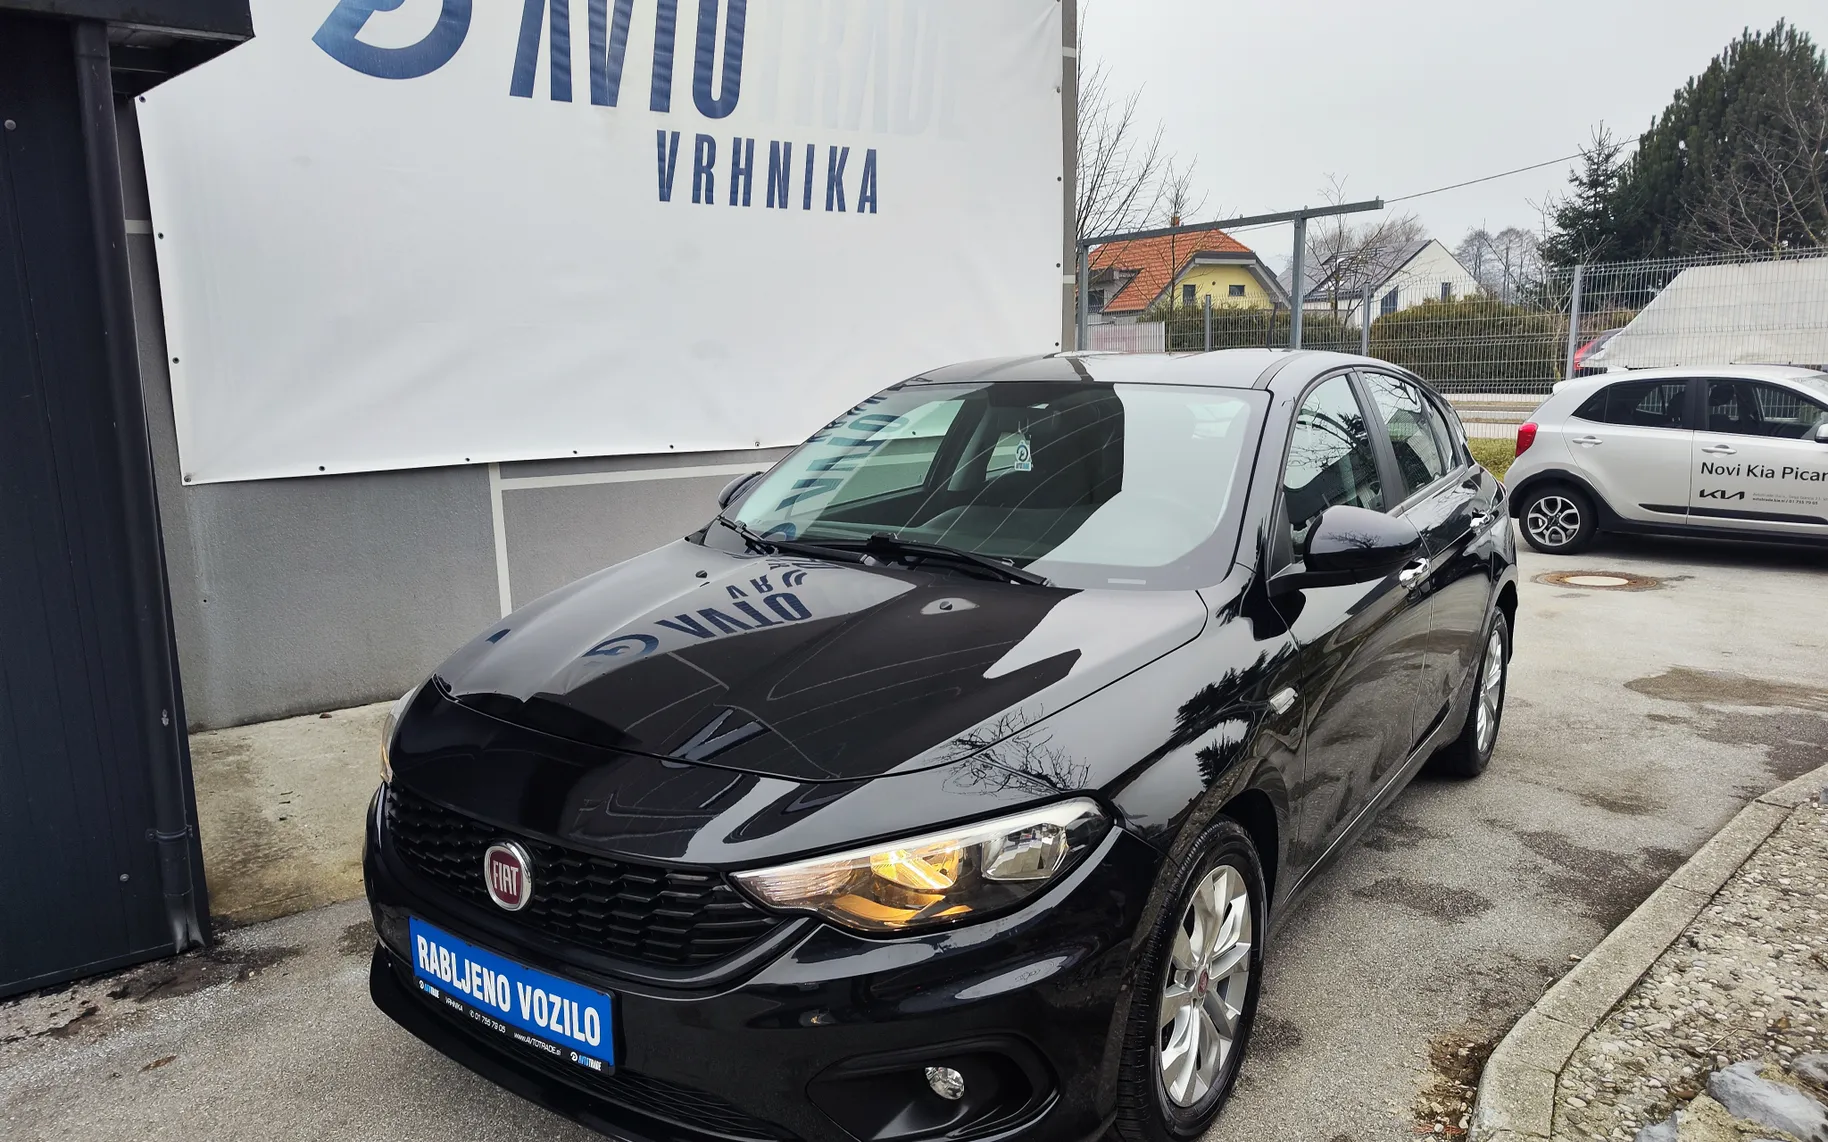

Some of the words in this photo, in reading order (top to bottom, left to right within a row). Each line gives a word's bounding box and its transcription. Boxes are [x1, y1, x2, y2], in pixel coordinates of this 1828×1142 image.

[656, 129, 878, 214] VRHNIKA
[1700, 461, 1741, 477] Novi
[1746, 464, 1776, 479] Kia
[492, 860, 519, 896] FIAT
[416, 934, 511, 1013] RABLJENO
[516, 981, 601, 1047] VOZILO
